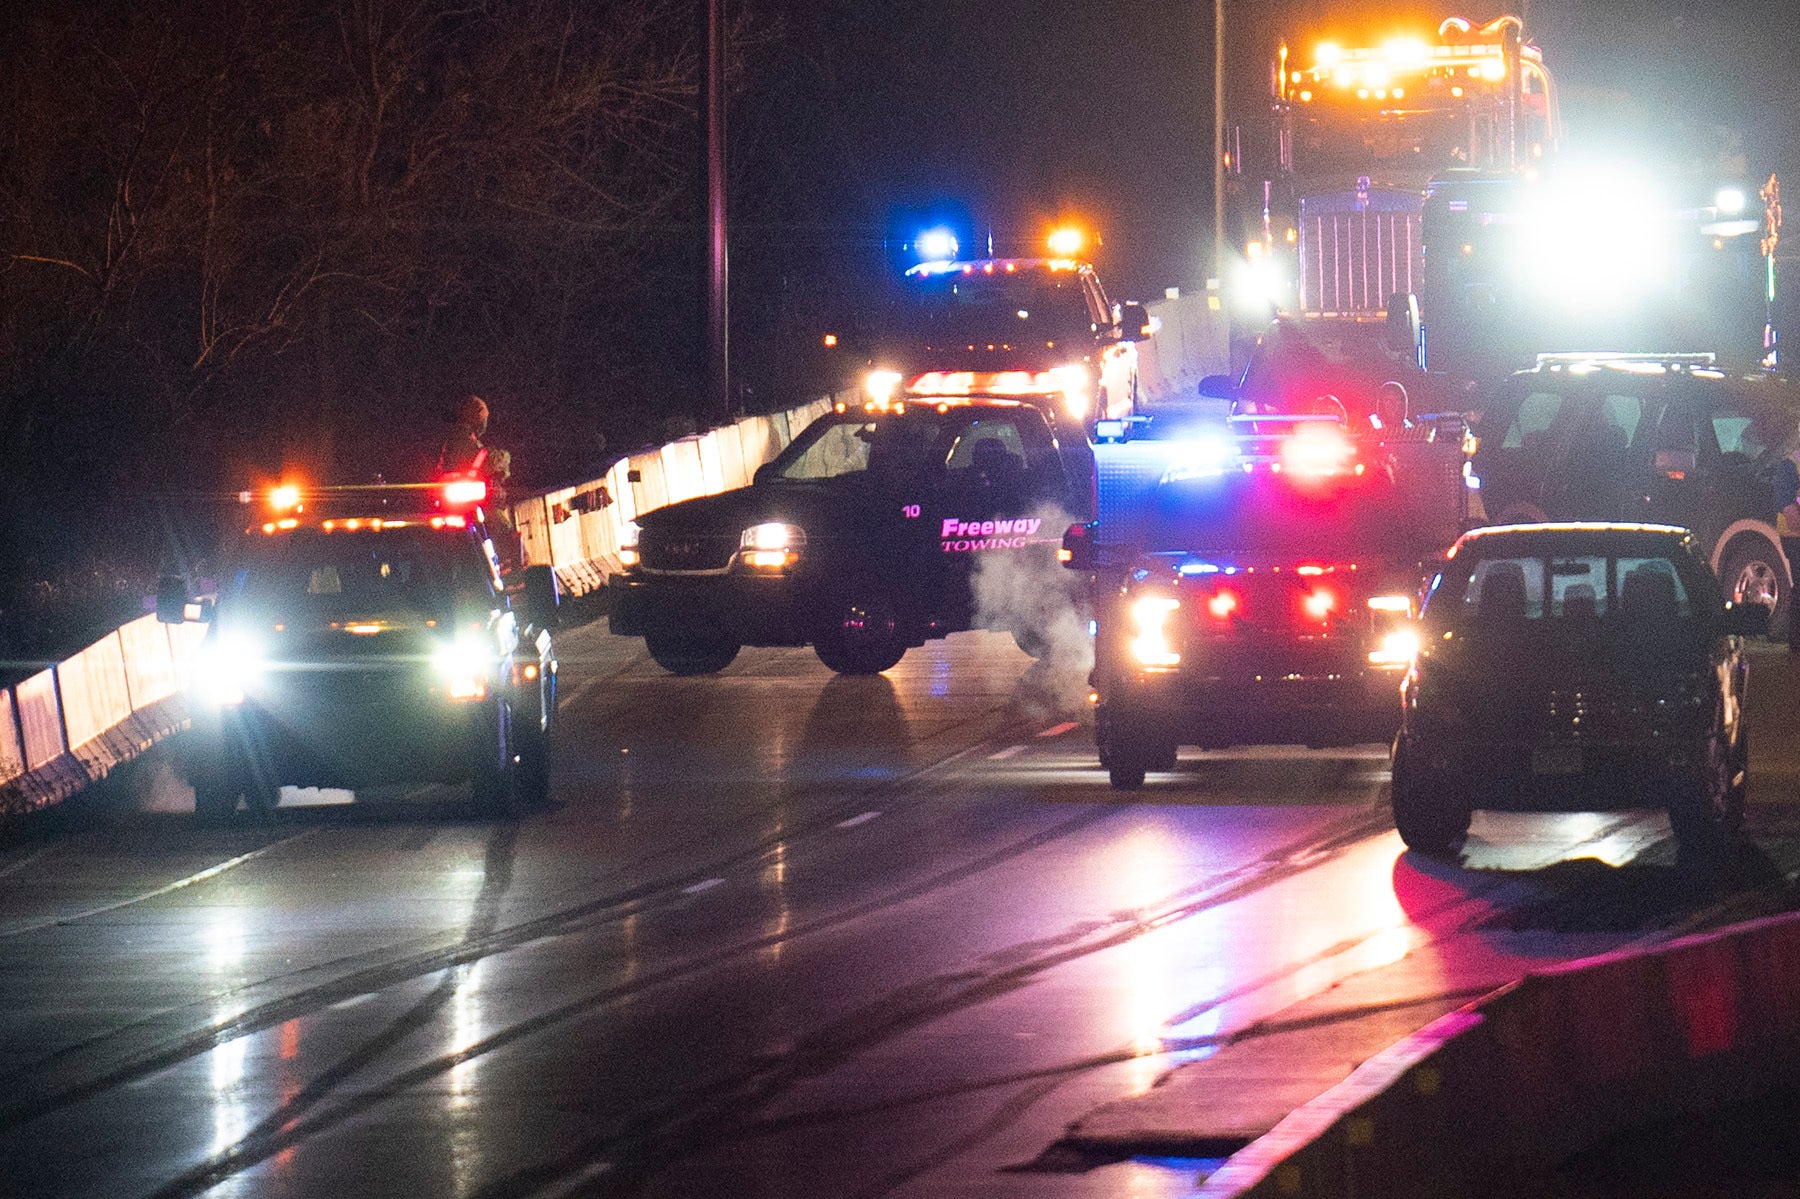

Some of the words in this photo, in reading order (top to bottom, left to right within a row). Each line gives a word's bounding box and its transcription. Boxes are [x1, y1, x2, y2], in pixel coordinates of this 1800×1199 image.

[902, 505, 920, 517] 10
[941, 518, 1041, 537] Freeway
[941, 538, 1026, 552] TOWING
